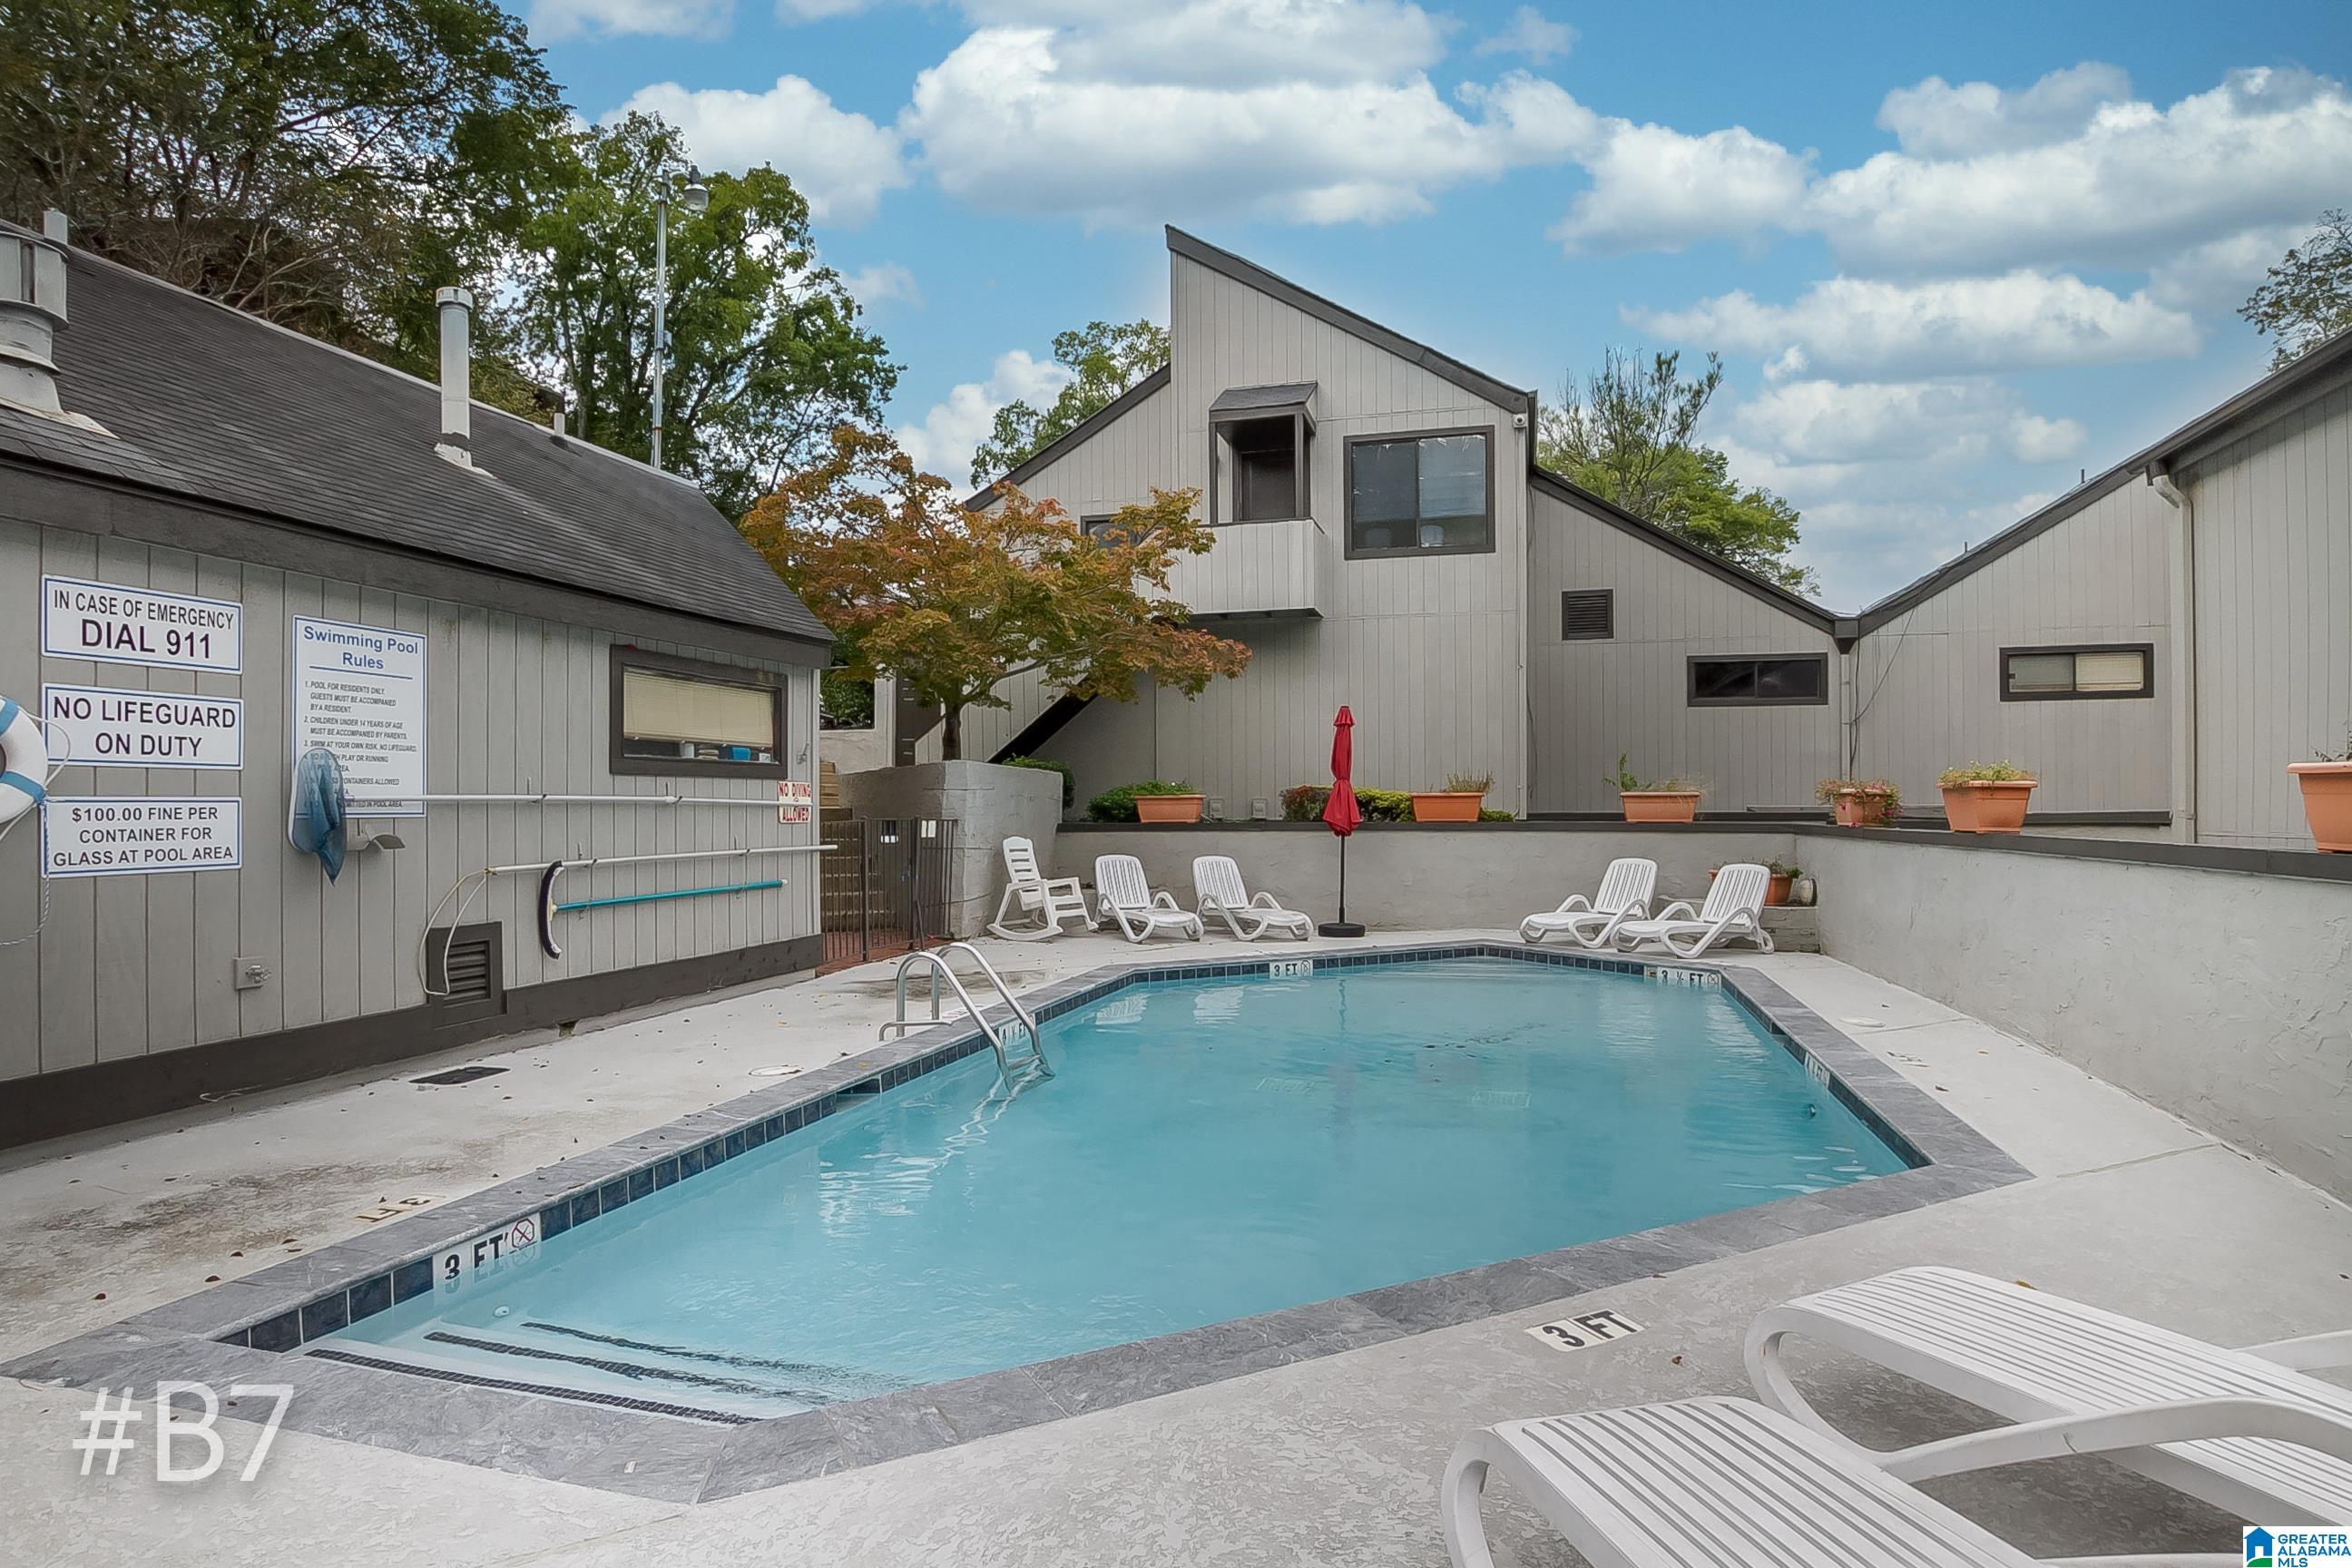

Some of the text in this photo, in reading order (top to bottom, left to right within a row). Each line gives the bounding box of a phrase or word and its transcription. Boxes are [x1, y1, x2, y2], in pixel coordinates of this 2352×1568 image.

[54, 590, 234, 629] IN CASE OF EMERGENCY
[82, 619, 210, 658] DIAL 911
[304, 626, 418, 654] Swimming Pool
[342, 652, 384, 669] Rules
[311, 681, 326, 689] POOL
[340, 684, 369, 694] RESIDENTS
[311, 692, 333, 701] GUESTS
[359, 697, 396, 706] ACCOMPANIED
[54, 696, 235, 728] NO LIFEGUARD
[310, 717, 338, 725] CHILDREN
[336, 729, 374, 738] ACCOMPANIED
[96, 733, 202, 757] ON DUTY
[779, 783, 811, 797] NO DIVING
[72, 807, 218, 822] $100.00 FINE PER
[783, 807, 809, 821] ALLOWED
[79, 827, 212, 843] CONTAINER FOR
[54, 847, 233, 866] GLASS AT POOL AREA
[1274, 963, 1298, 977] 3 FT
[1690, 973, 1703, 983] FT
[355, 1208, 403, 1223] FT
[445, 1254, 460, 1280] 3
[1543, 1310, 1638, 1347] 3 FT
